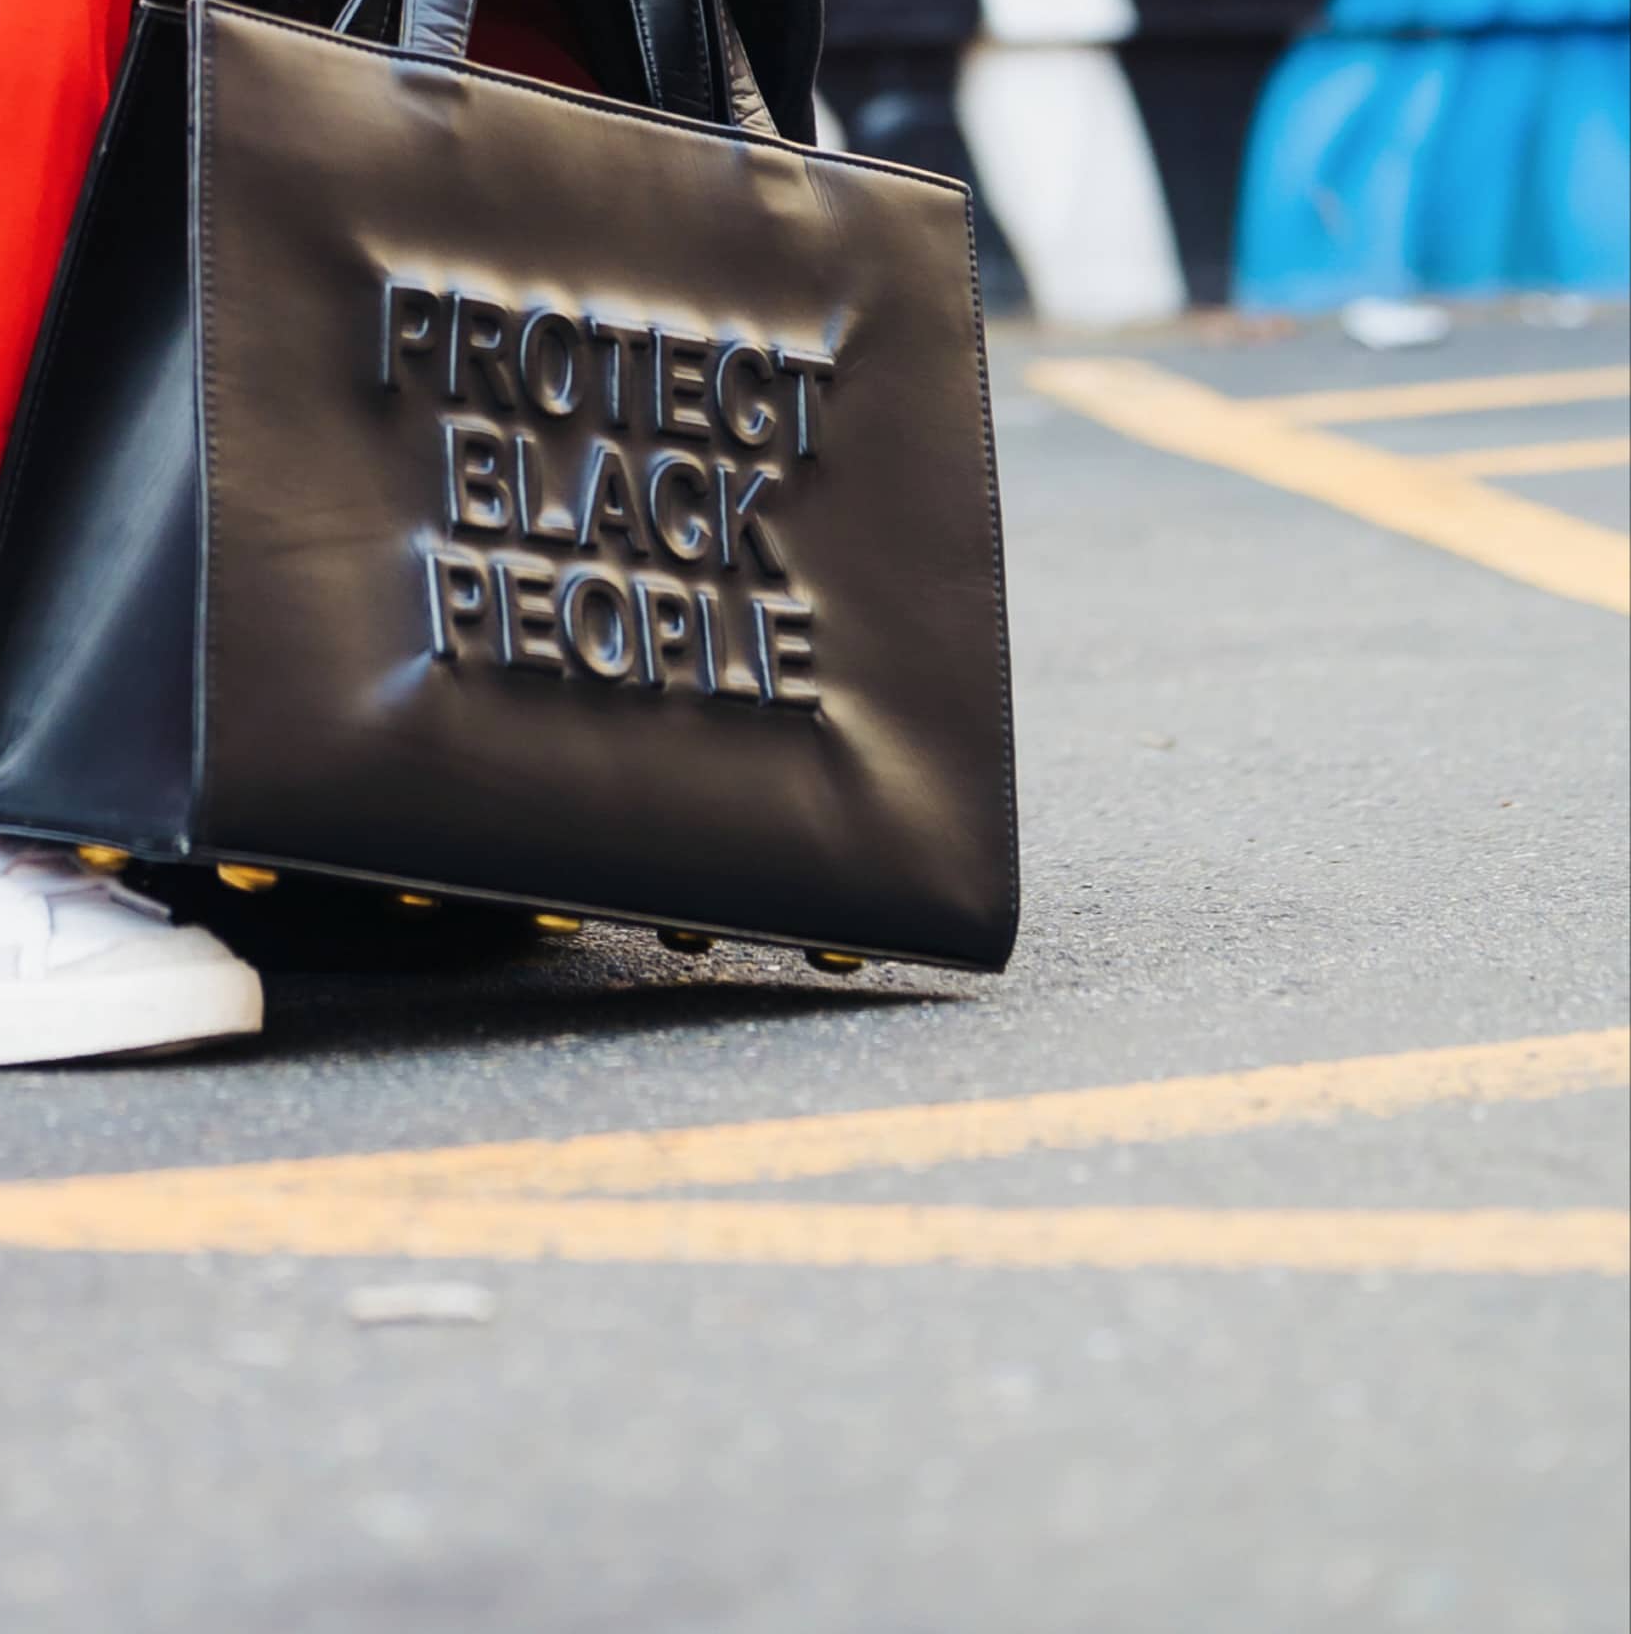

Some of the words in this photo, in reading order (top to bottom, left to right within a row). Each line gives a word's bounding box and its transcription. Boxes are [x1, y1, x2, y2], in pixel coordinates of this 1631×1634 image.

[380, 279, 836, 459] PROTECT
[441, 416, 788, 580] BLACK
[426, 547, 821, 712] PEOPLE
